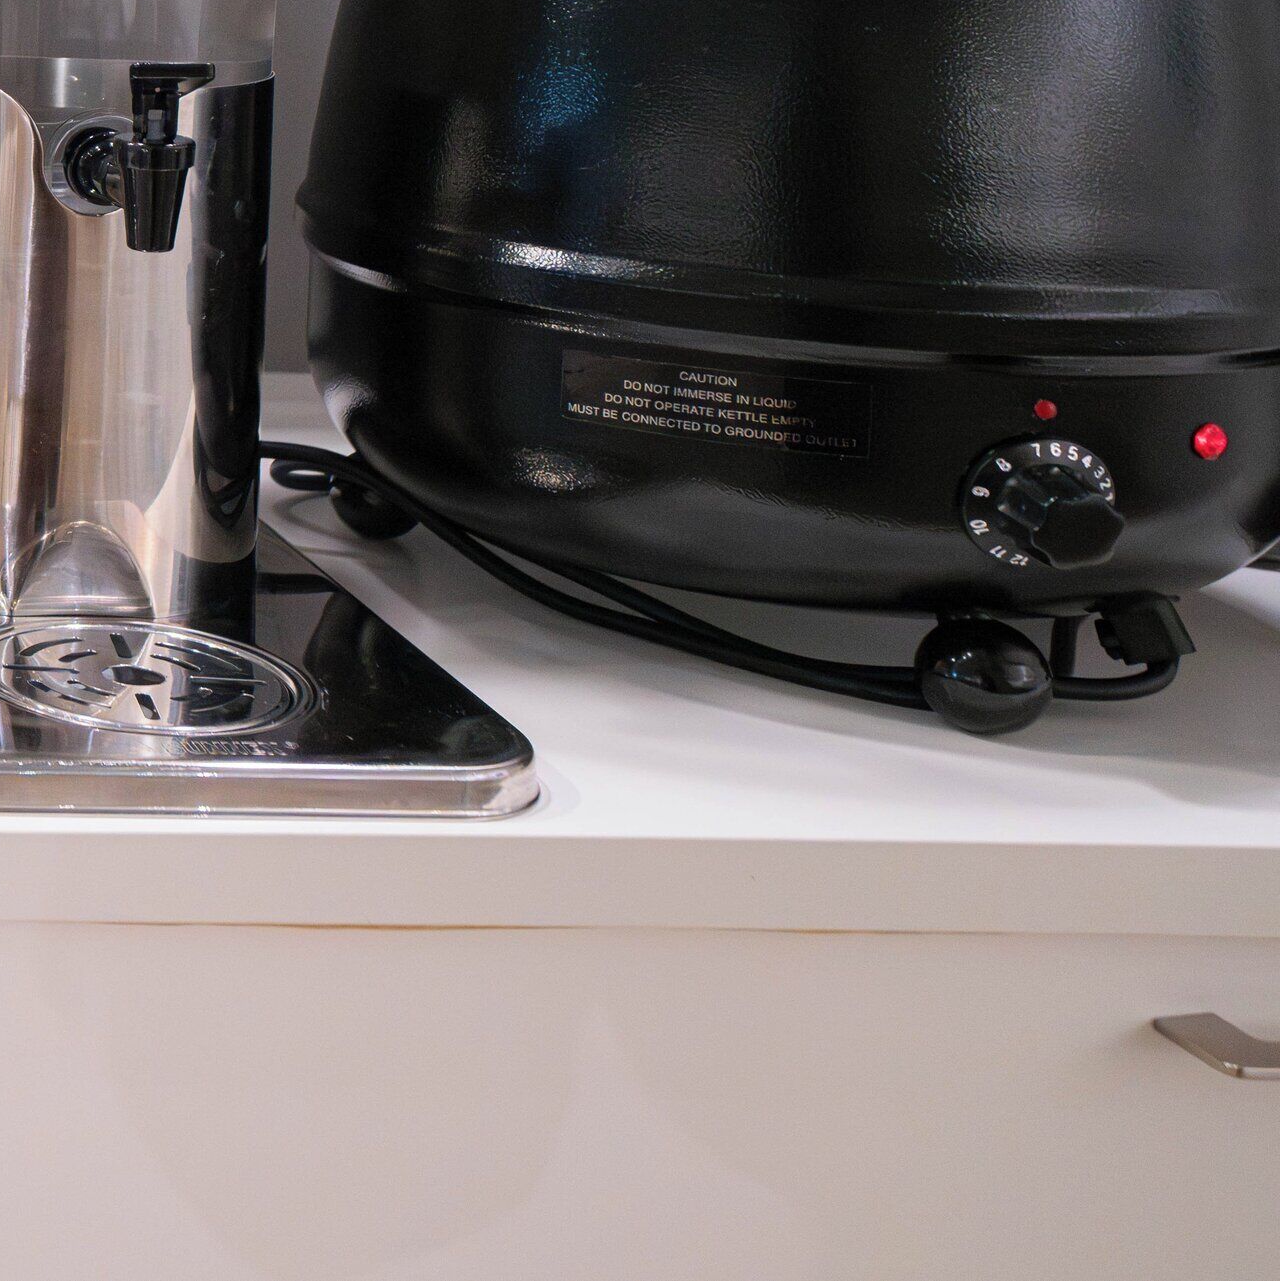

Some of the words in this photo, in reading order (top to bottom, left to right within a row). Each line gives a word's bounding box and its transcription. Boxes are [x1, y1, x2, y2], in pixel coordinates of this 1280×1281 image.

[679, 371, 737, 387] CAUTION
[623, 379, 642, 391] DO
[644, 383, 671, 395] NOT
[673, 387, 732, 402] IMMERSE
[736, 394, 750, 405] IN
[753, 396, 797, 410] LIQUID
[604, 392, 623, 404] DO
[625, 396, 652, 409] NOT
[654, 401, 715, 417] OPERATE
[718, 408, 768, 424] KETTLE
[568, 402, 600, 416] MUST
[602, 408, 618, 420] BE
[621, 412, 701, 431] CONNECTED
[704, 423, 722, 435] TO
[724, 426, 801, 443] GROUNDED
[1030, 443, 1040, 457] 7
[1050, 442, 1062, 457] 6
[1068, 446, 1078, 461] 5
[995, 458, 1012, 472] 8
[1082, 455, 1092, 468] 4
[1094, 466, 1105, 478] 3
[1100, 478, 1111, 490] 2
[971, 486, 990, 497] 9
[969, 519, 989, 536] 10
[989, 545, 1007, 559] 11
[1009, 553, 1029, 567] 12
